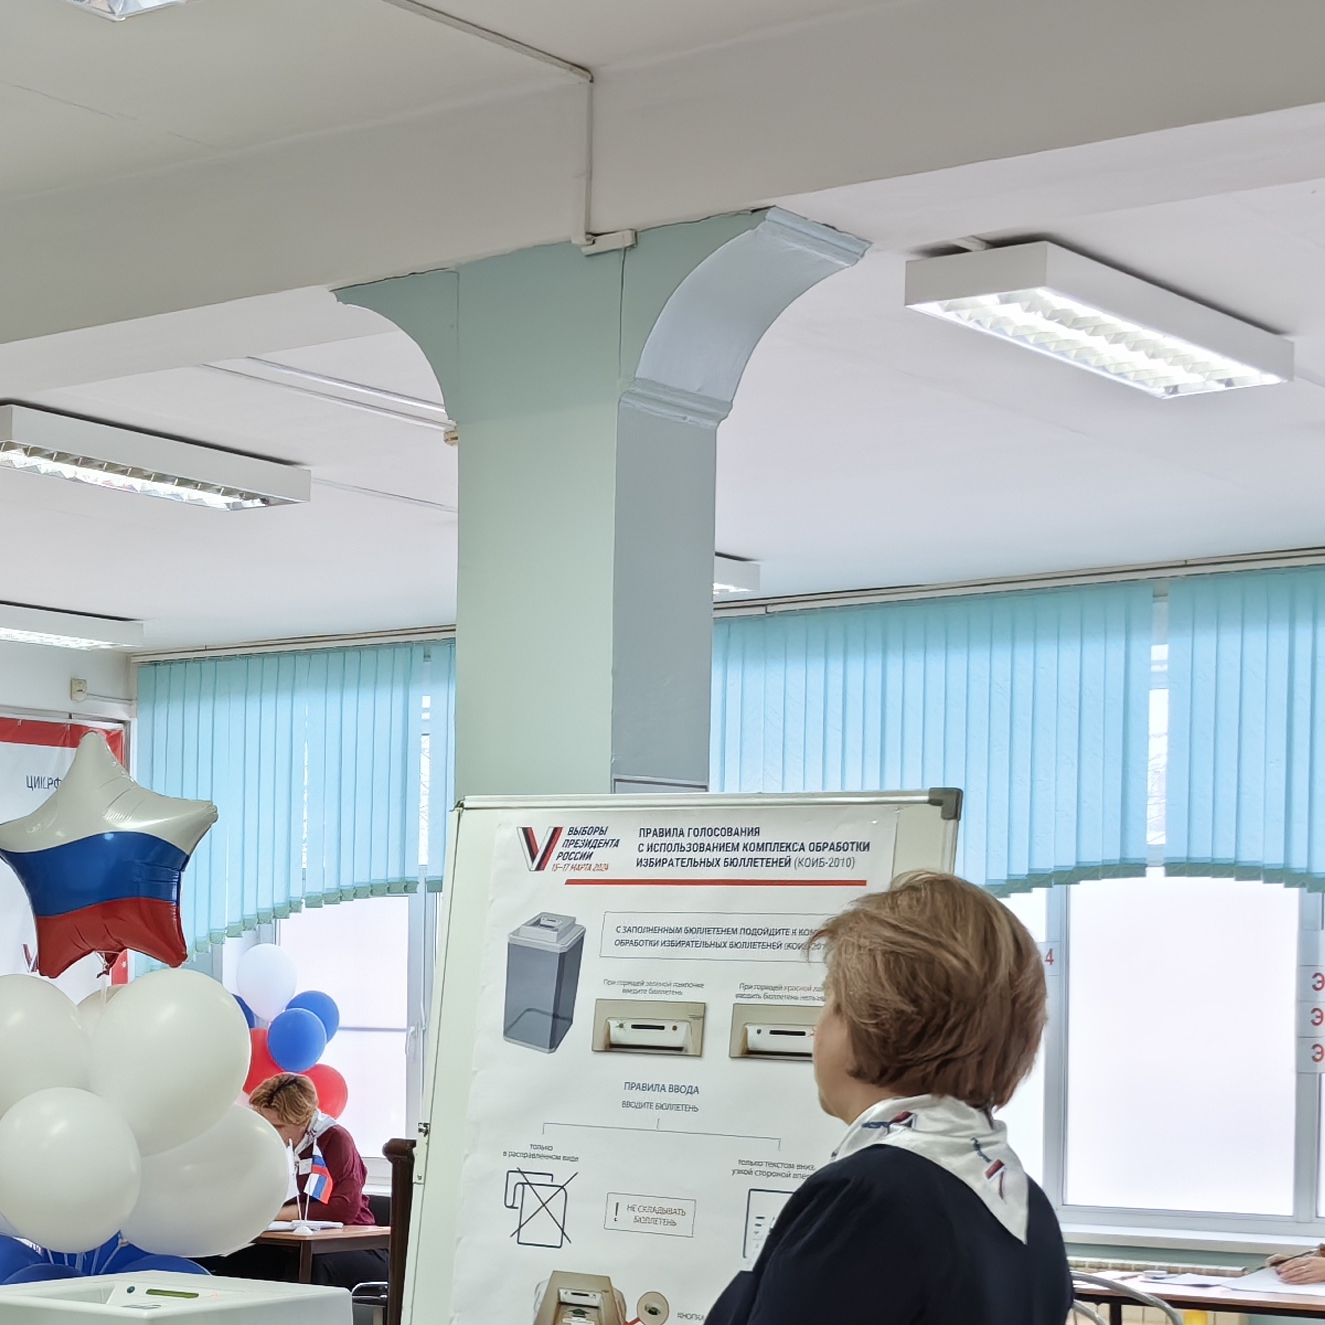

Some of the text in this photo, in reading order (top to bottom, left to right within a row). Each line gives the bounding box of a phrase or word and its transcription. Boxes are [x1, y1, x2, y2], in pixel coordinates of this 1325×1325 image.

[567, 826, 609, 836] ВЫБОРЫ
[638, 826, 760, 838] ПРАВИЛА ГОЛОСОВАНИЯ
[562, 838, 620, 850] ПРЕЗИДЕНТА
[637, 841, 870, 853] С ИСПОЛЬЗОВАНИЕМ КОМПЛЕКСА ОБРАБОТКИ
[556, 852, 594, 861] РОССИИ
[636, 856, 856, 870] ИЗБИРАТЕЛЬНЫХ БЮЛЛЕТЕНЕЙ (КОИБ-2010)
[624, 1082, 700, 1095] ПРАВИЛА ВВОДА
